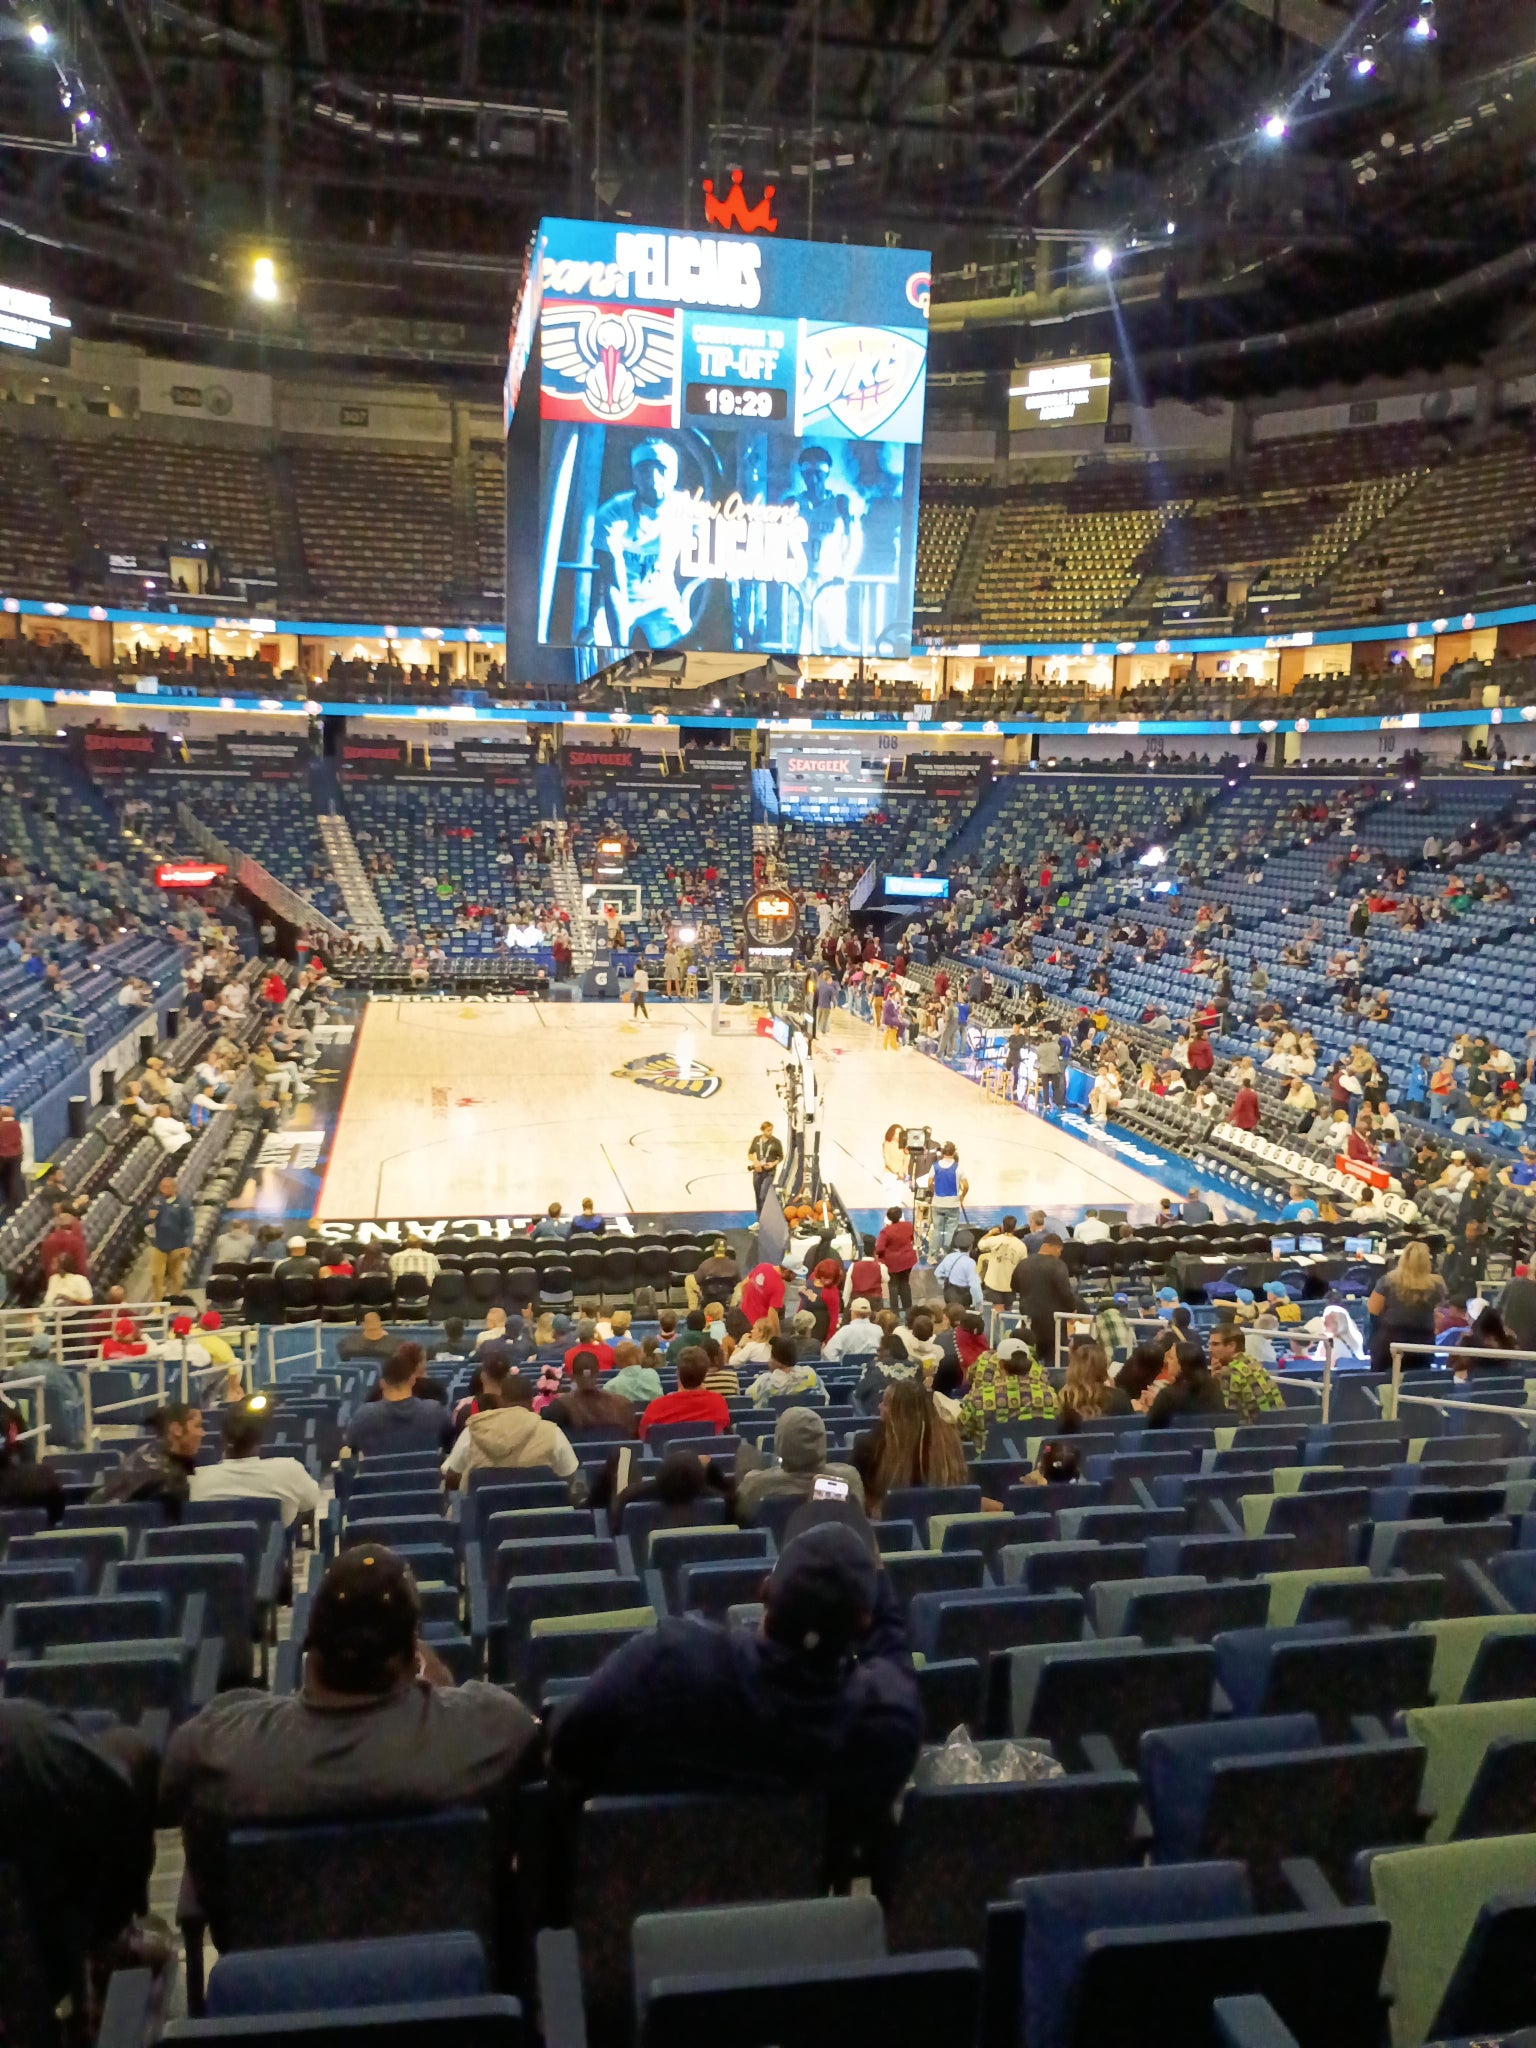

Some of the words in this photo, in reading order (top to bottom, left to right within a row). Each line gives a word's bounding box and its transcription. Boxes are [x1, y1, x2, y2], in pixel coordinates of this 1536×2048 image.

[616, 232, 761, 309] PELICANS
[697, 345, 780, 380] TIP-OFF
[878, 735, 898, 749] 108
[788, 758, 849, 774] SEATGEEK
[803, 1156, 813, 1199] NBA
